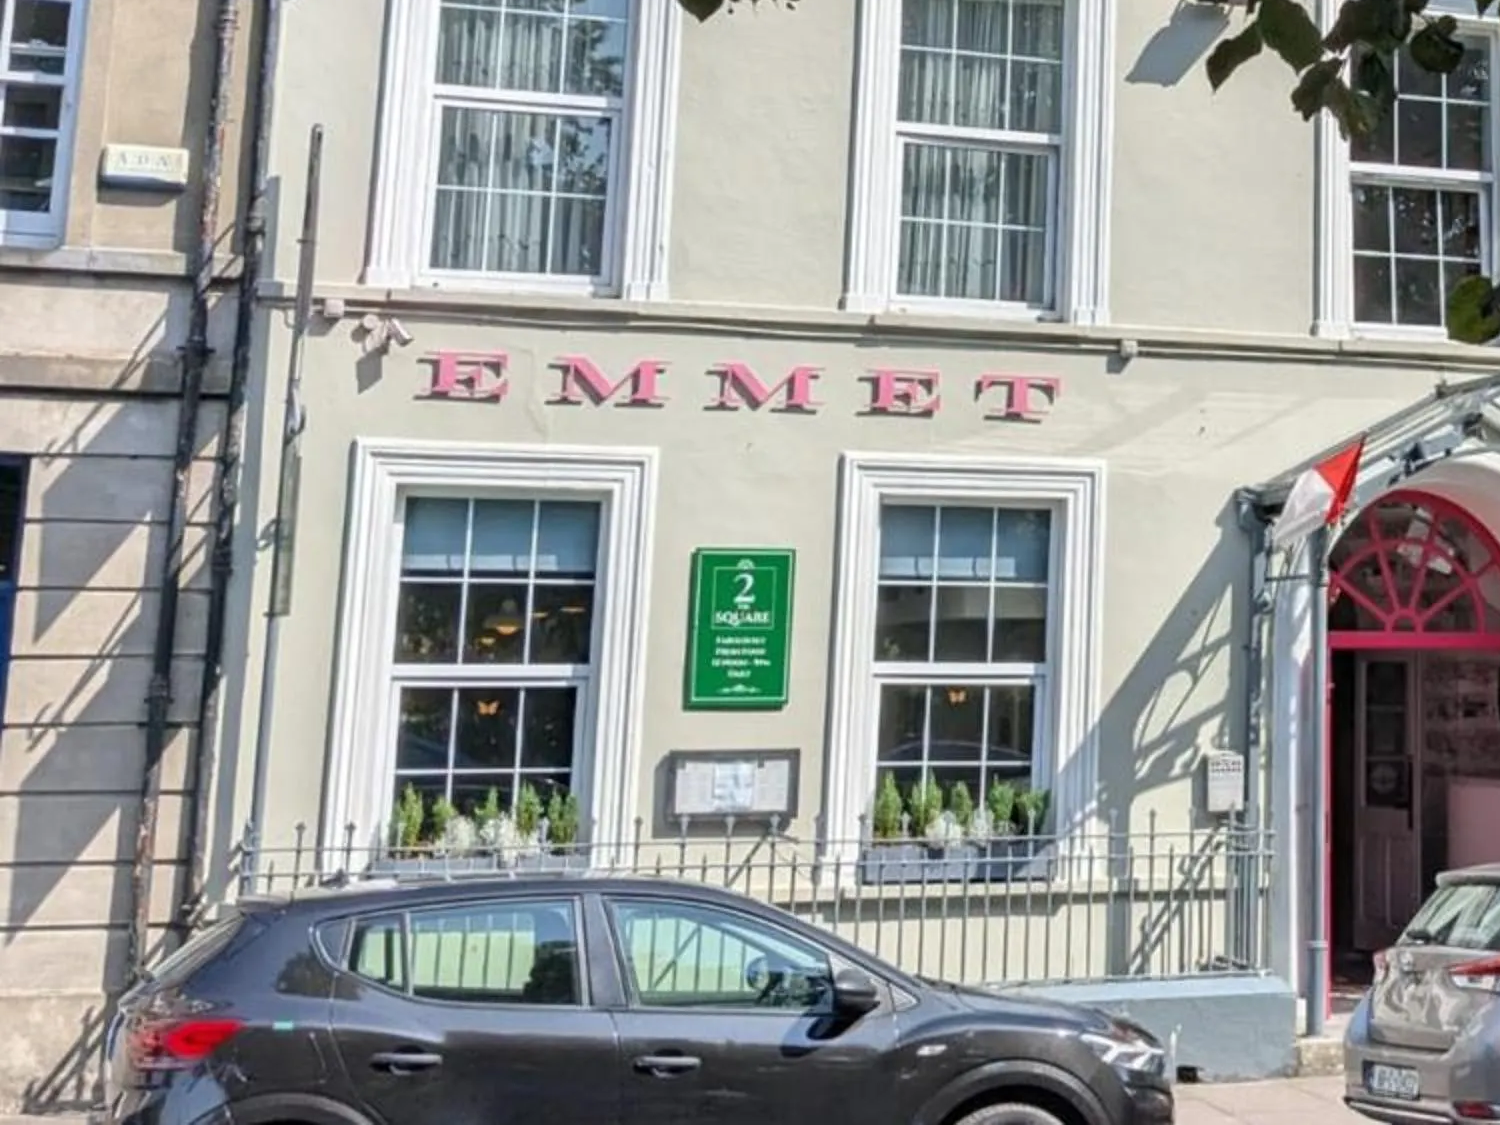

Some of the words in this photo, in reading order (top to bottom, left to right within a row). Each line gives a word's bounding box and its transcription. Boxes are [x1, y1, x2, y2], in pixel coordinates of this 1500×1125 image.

[414, 350, 1061, 424] EMMET
[733, 573, 756, 603] 2
[714, 610, 770, 626] SQUARE
